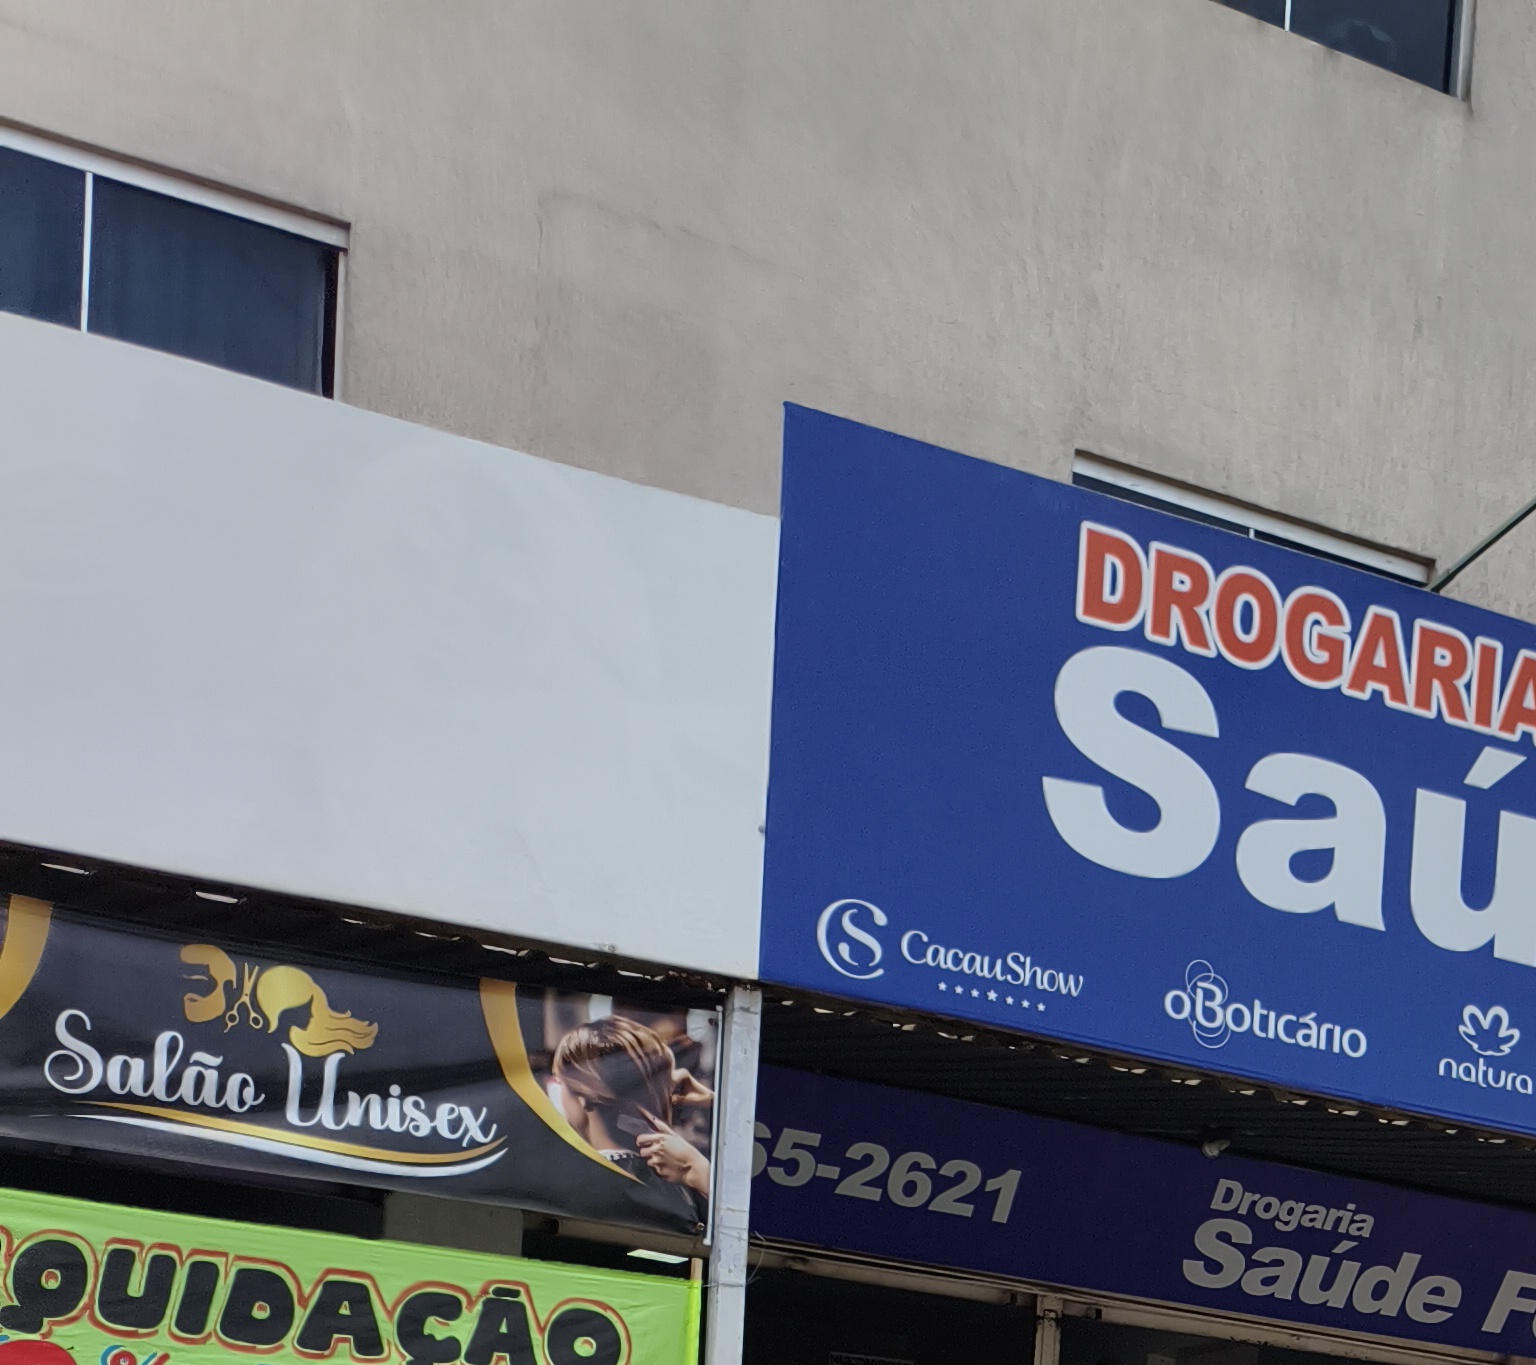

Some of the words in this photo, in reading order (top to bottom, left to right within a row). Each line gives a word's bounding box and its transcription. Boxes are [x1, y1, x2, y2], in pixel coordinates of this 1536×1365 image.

[44, 1009, 265, 1113] Salão
[281, 1043, 497, 1148] Unisex
[1437, 1057, 1534, 1095] natura
[1210, 1178, 1375, 1240] Drogaria
[1182, 1219, 1462, 1325] Saúde
